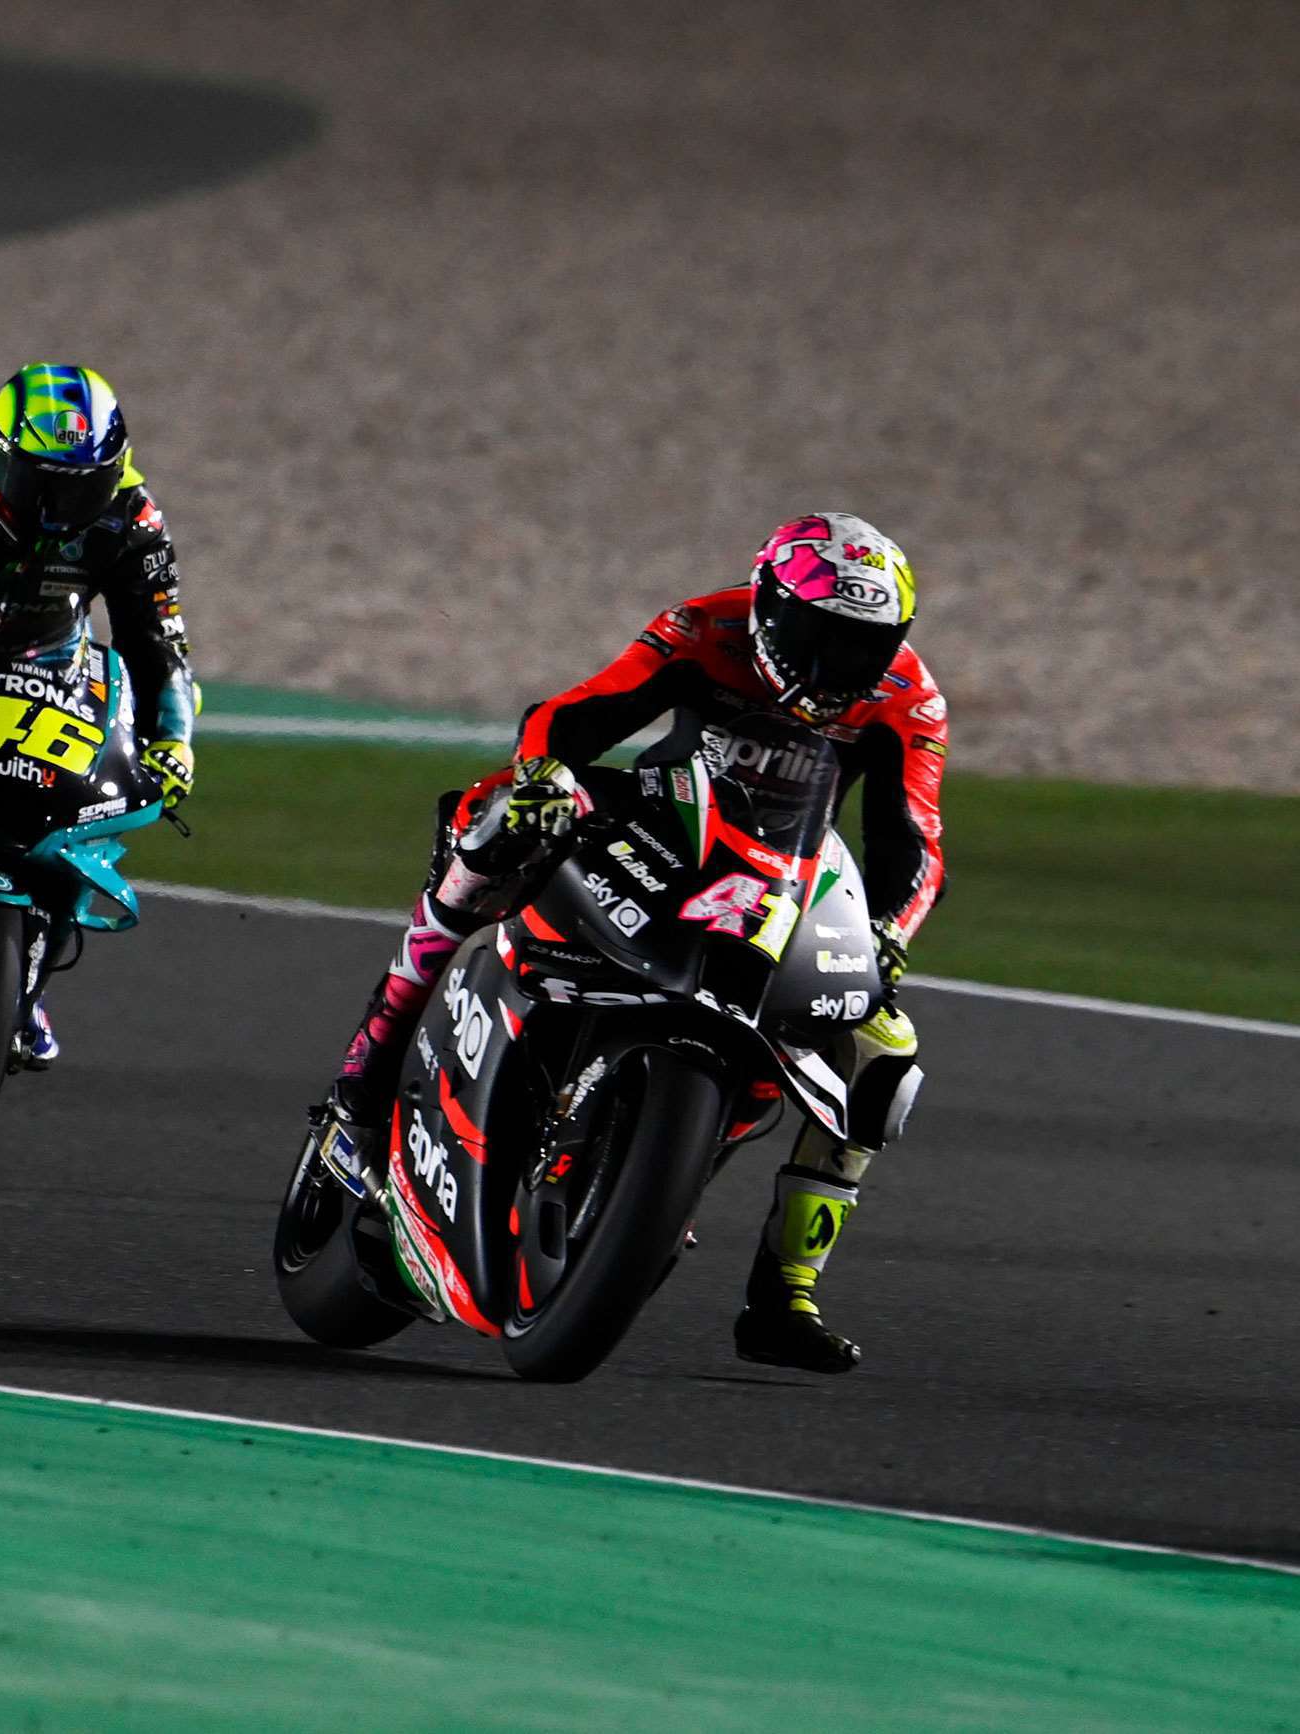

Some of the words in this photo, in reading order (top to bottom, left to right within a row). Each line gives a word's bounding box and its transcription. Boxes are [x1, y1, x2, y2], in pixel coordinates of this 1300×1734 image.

[11, 662, 54, 681] YAMAHA
[77, 796, 128, 819] SEPANG
[627, 820, 685, 869] kaspersky
[676, 872, 801, 964] 41
